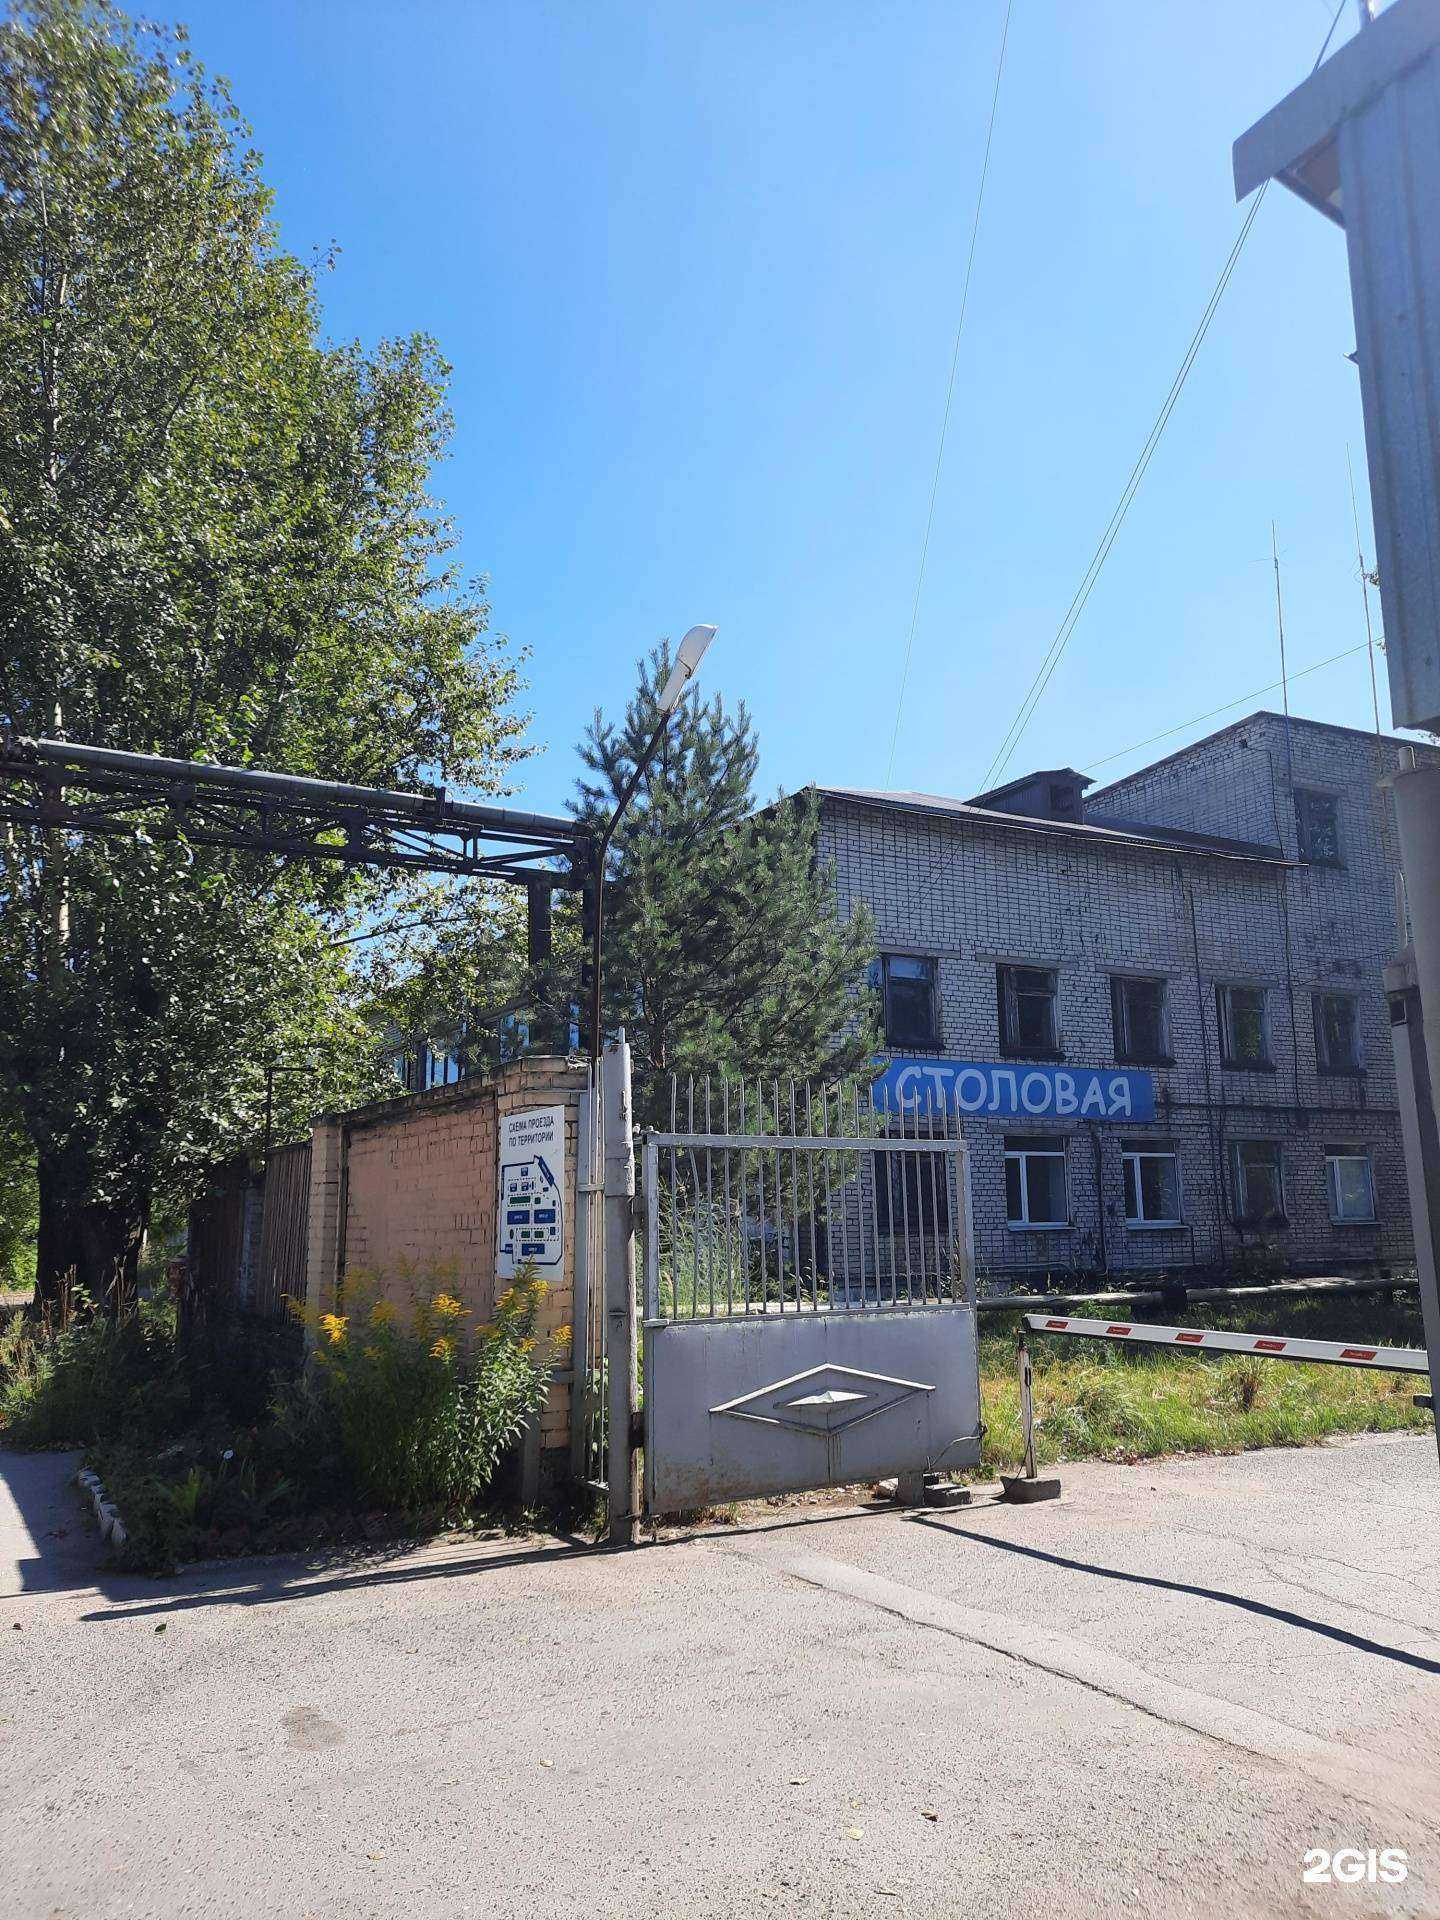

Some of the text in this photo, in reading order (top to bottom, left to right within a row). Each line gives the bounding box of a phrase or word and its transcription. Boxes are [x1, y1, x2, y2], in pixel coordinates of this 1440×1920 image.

[896, 1065, 1131, 1117] СТОЛОВАЯ
[509, 1116, 554, 1133] СХЕМА ПРОЕЗДА
[509, 1131, 554, 1147] ПО ТЕРРИТОРИИ
